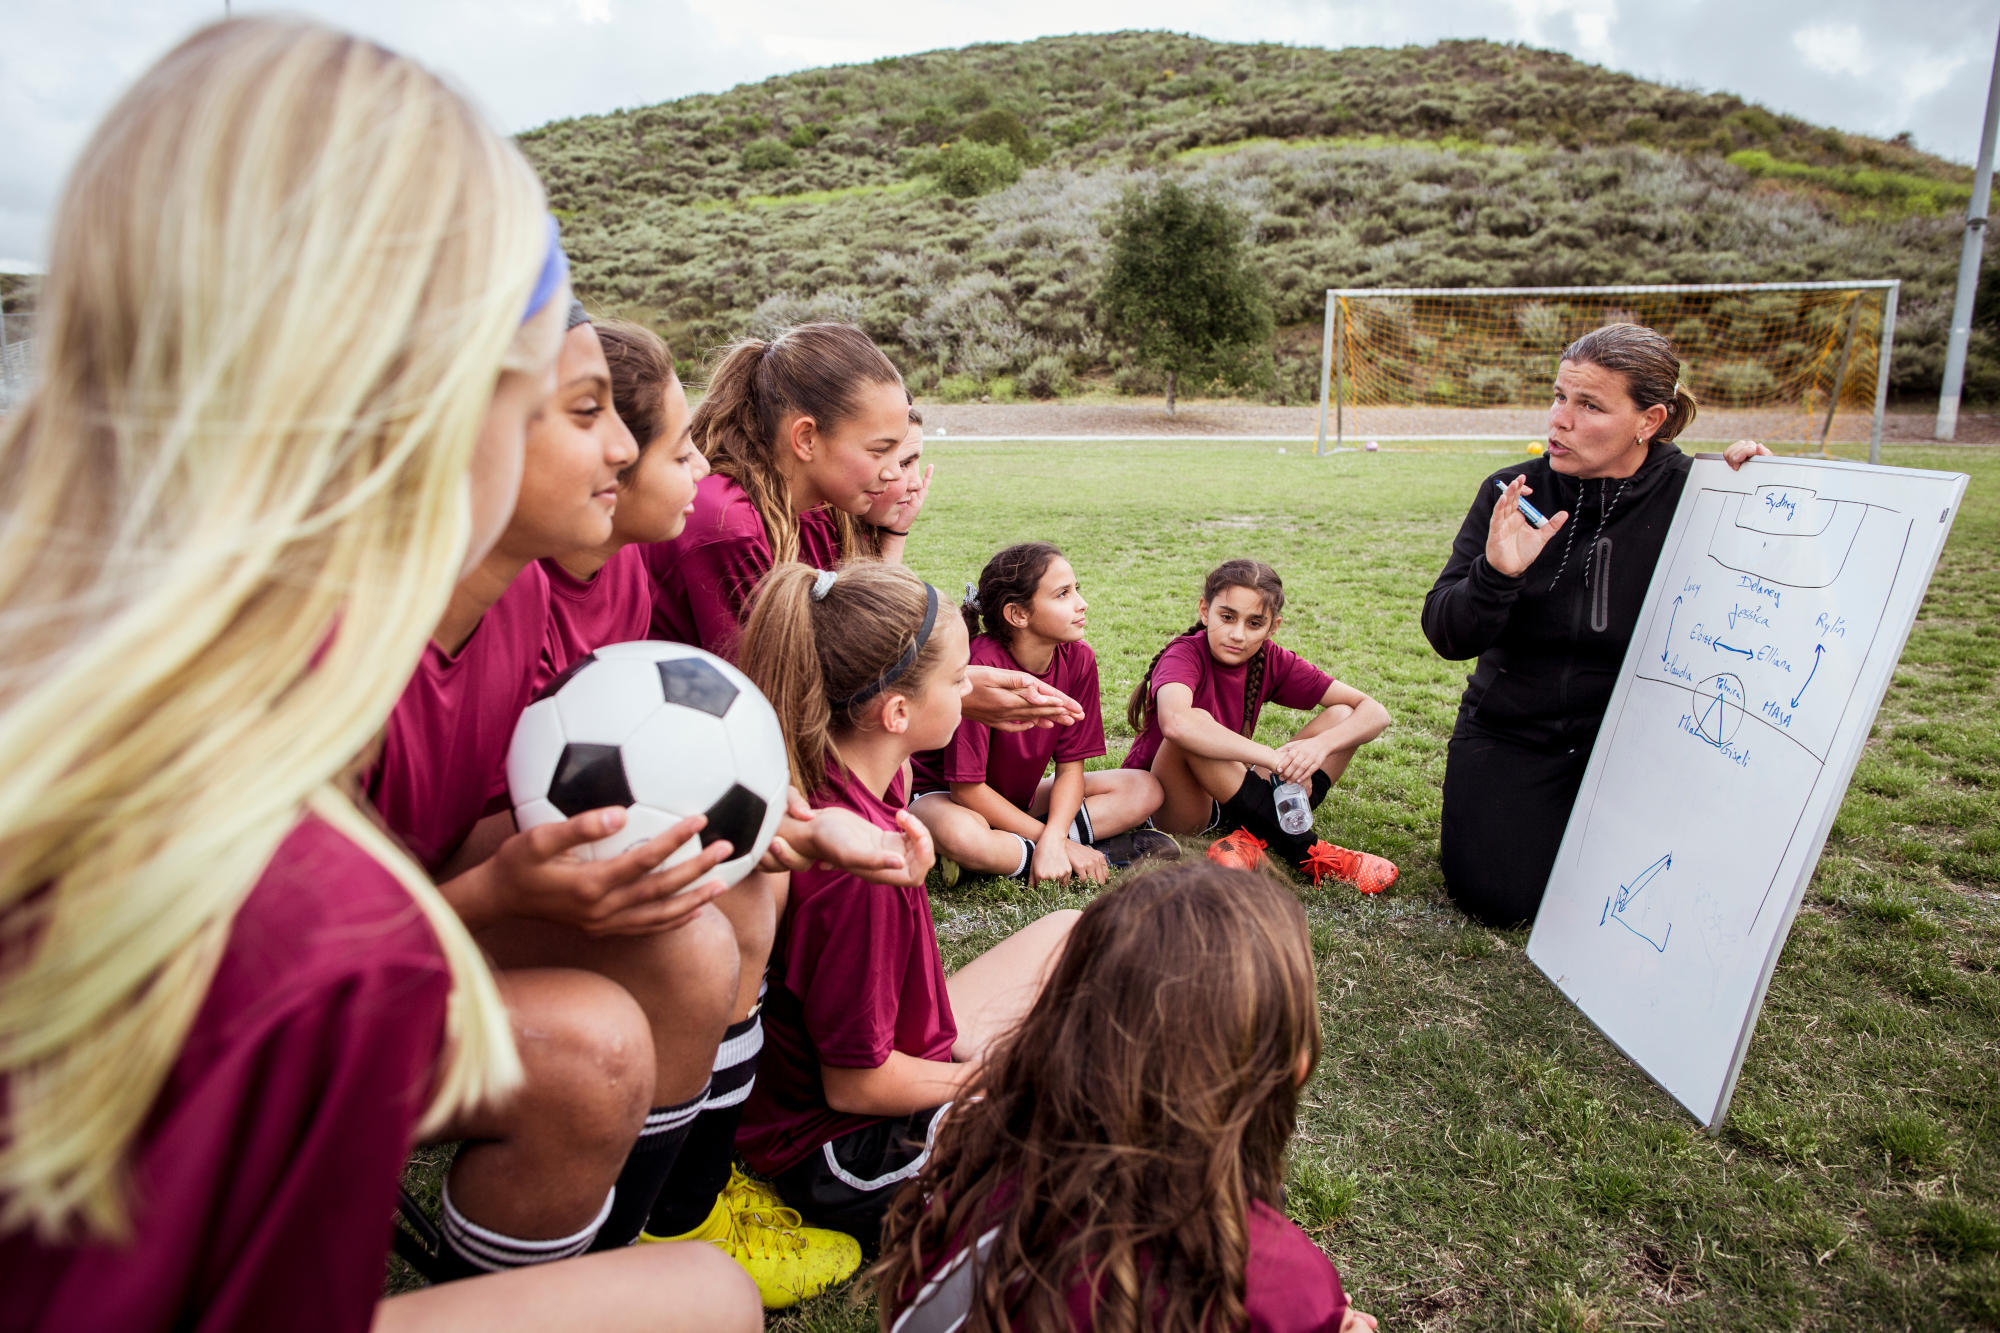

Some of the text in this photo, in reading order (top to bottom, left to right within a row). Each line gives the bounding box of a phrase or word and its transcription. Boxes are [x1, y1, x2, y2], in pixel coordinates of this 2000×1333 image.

[1765, 492, 1797, 522] Sydney
[1683, 575, 1701, 598] Lucy
[1736, 575, 1781, 609] Delaney
[1728, 603, 1771, 630] Jessica
[1689, 623, 1713, 646] Eloise
[1756, 645, 1792, 673] Elliana
[1678, 714, 1696, 736] Mia
